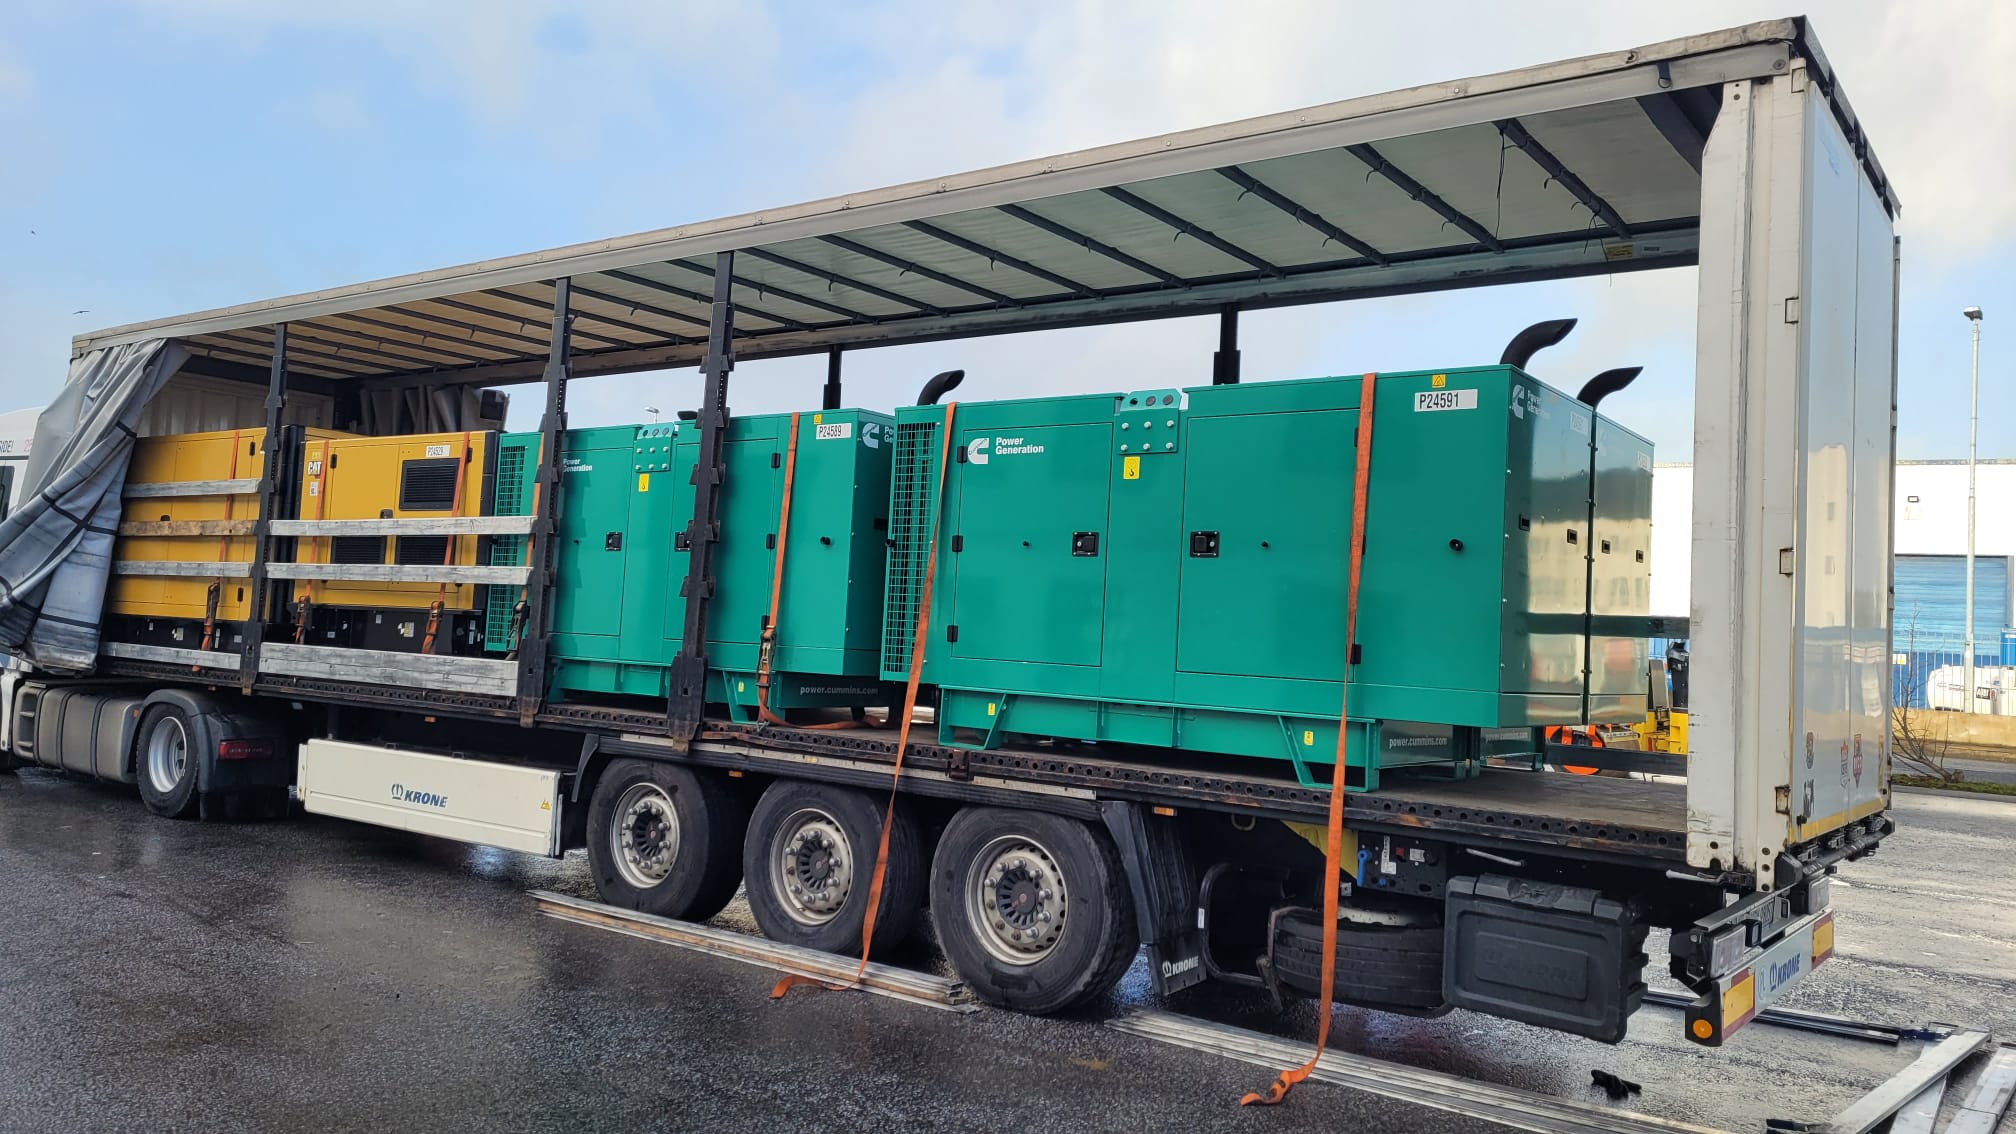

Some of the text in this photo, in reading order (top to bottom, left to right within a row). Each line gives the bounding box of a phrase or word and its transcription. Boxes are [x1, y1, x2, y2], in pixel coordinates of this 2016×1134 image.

[1420, 392, 1459, 409] P24591
[819, 425, 842, 438] P24589
[996, 437, 1024, 446] Power
[996, 444, 1044, 455] Generation
[307, 461, 322, 475] CAT
[800, 685, 879, 695] power.cummins.com
[1389, 736, 1448, 749] power.cummins.com
[404, 789, 449, 808] KRONE
[1172, 955, 1199, 975] KRONE
[1778, 953, 1801, 986] KRONE
